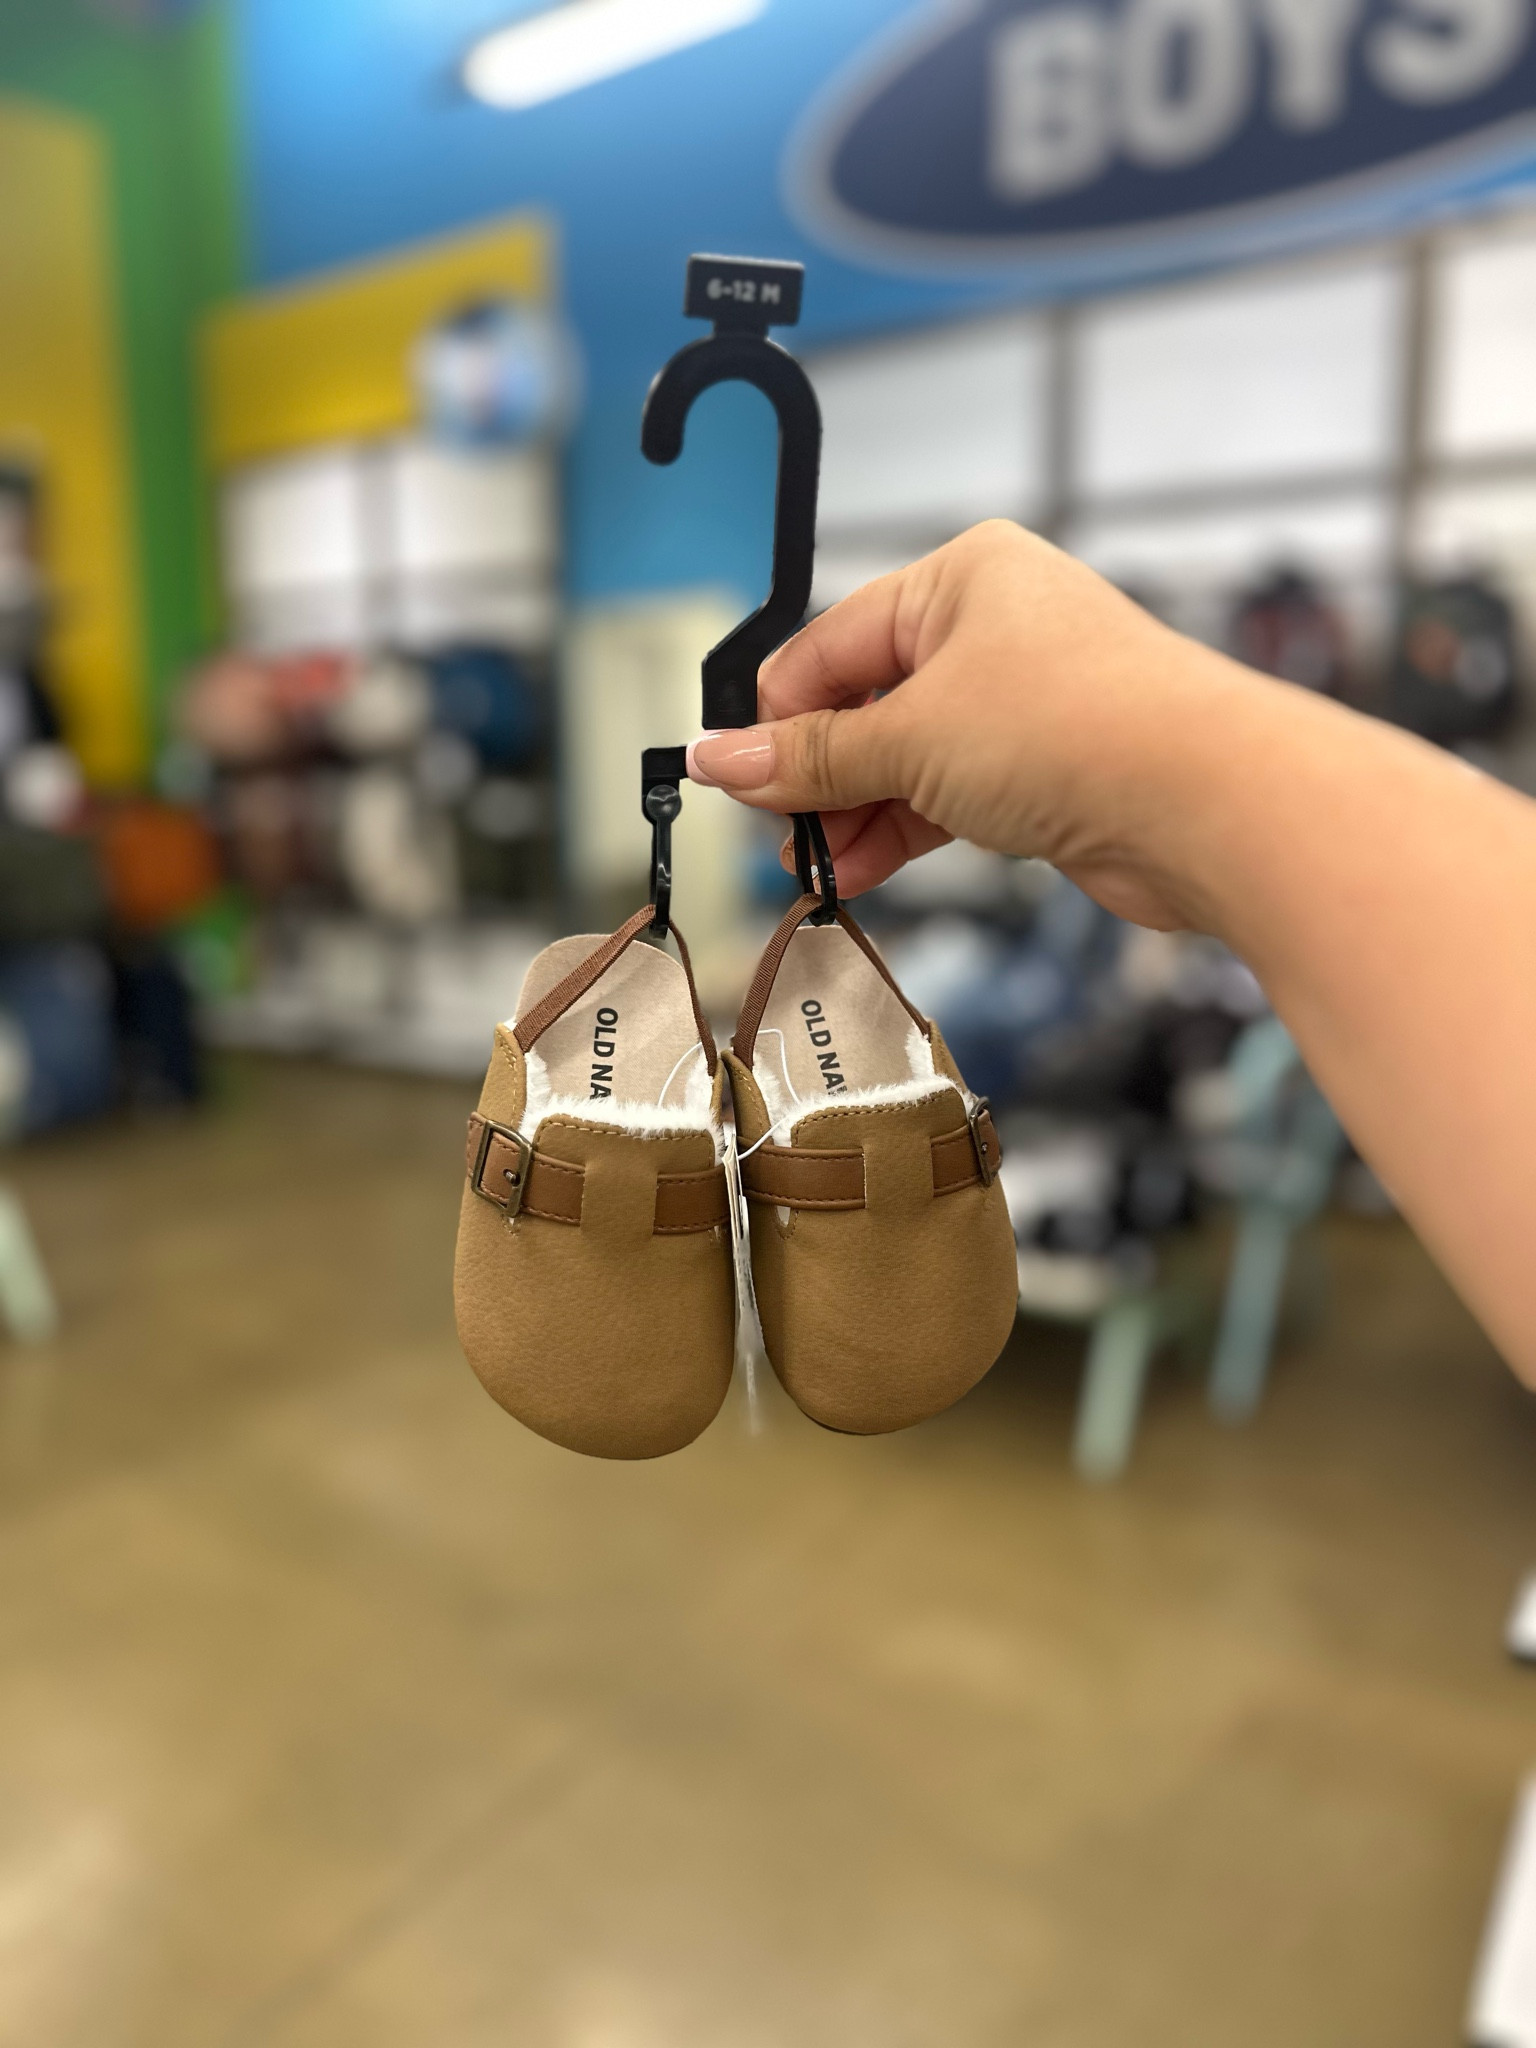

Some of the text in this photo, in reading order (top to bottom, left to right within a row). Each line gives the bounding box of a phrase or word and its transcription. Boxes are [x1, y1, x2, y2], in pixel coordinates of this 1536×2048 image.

[990, 0, 1524, 197] BOYS
[706, 278, 782, 305] 6-12 M
[593, 1007, 619, 1058] OLD
[801, 999, 832, 1047] OLD
